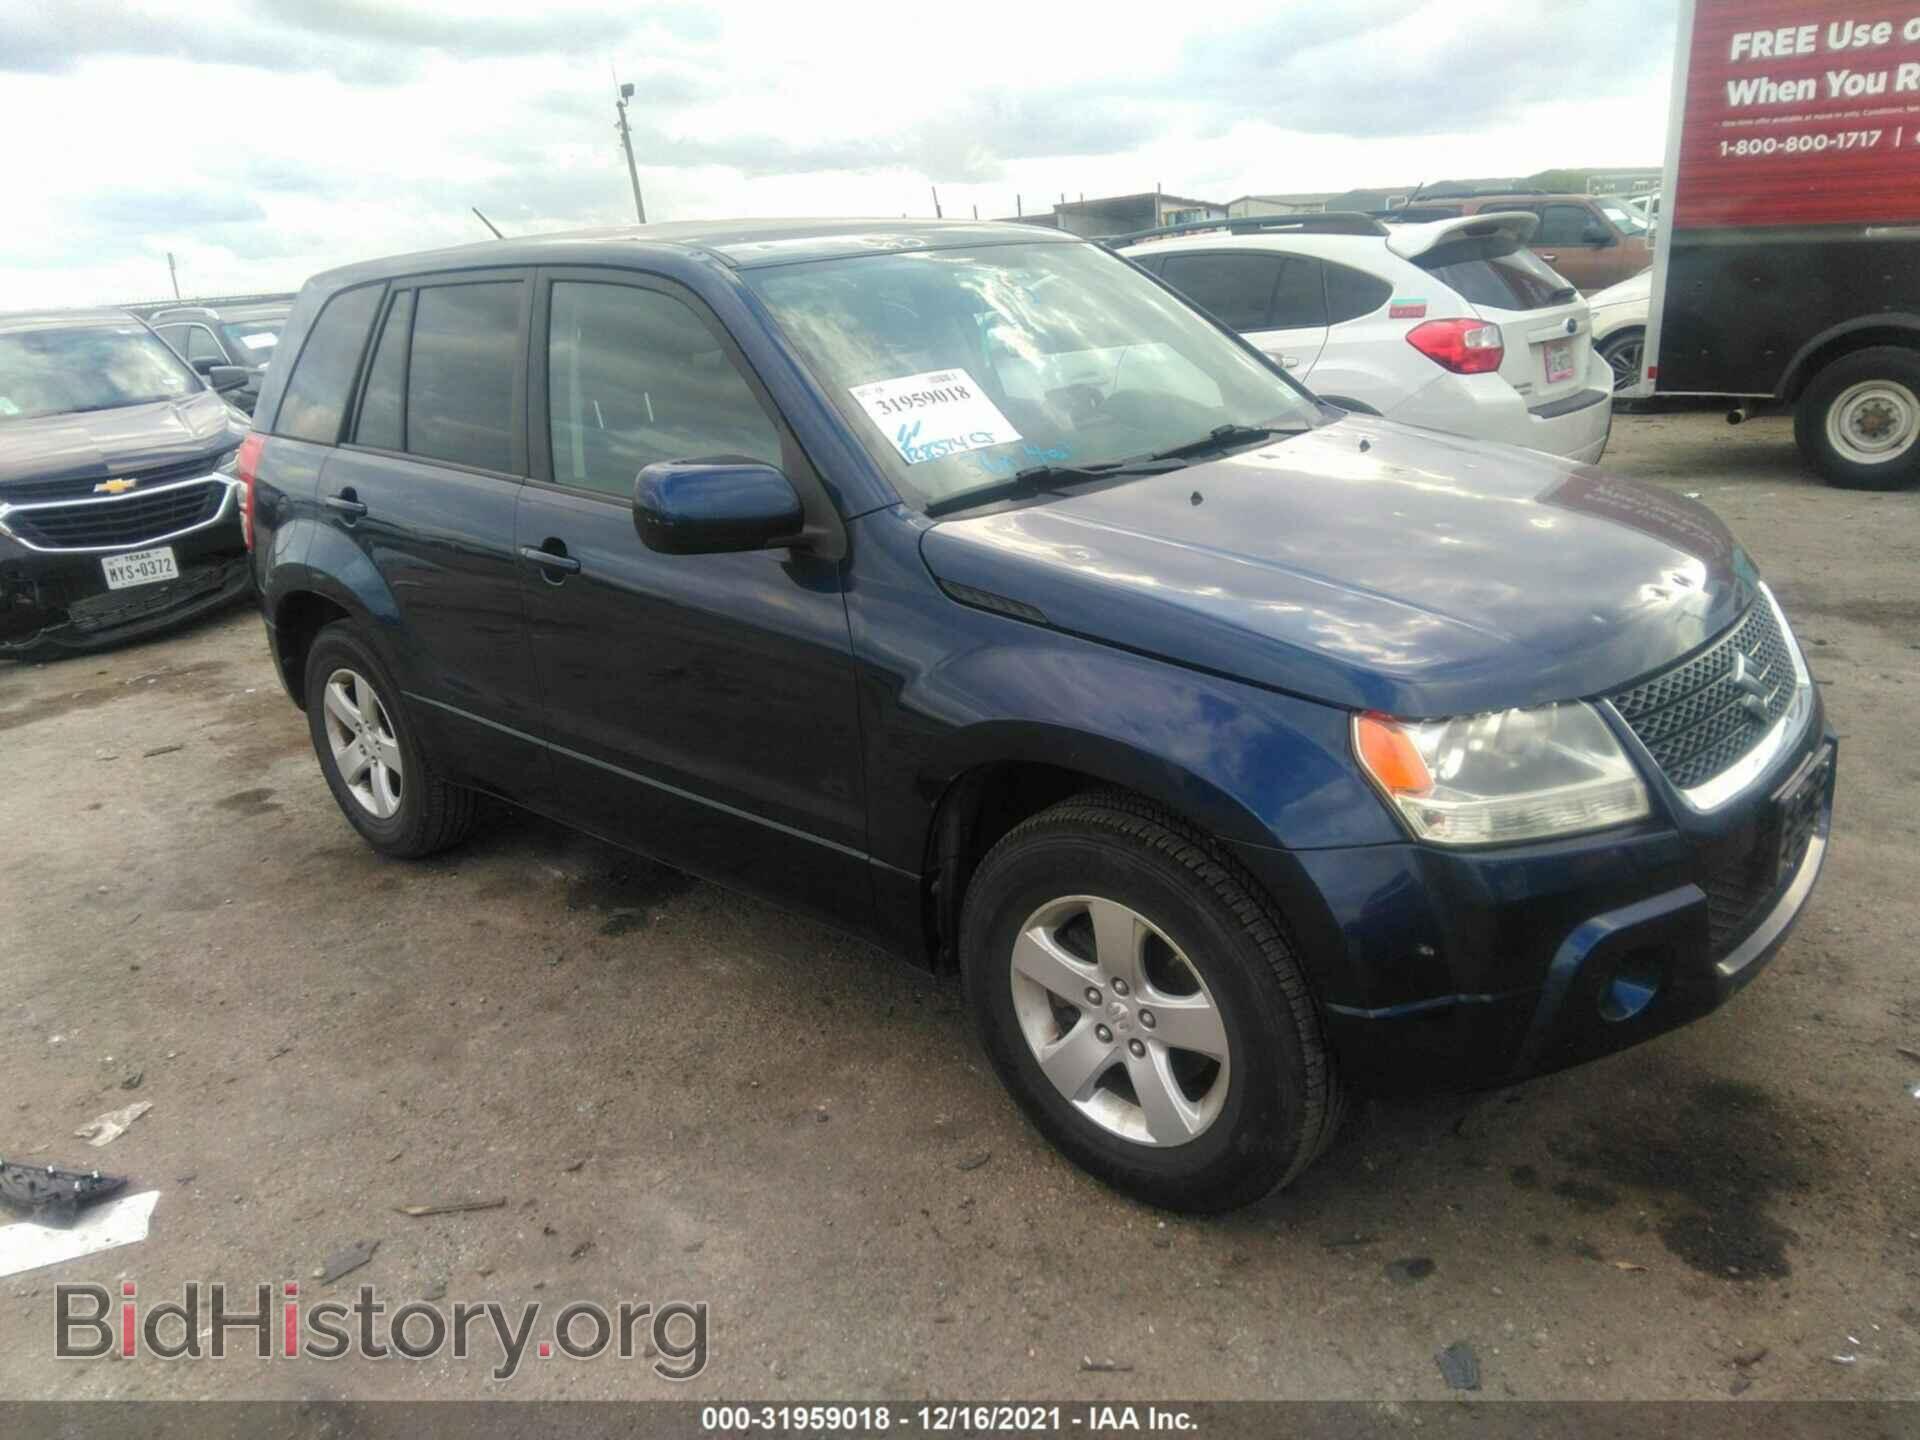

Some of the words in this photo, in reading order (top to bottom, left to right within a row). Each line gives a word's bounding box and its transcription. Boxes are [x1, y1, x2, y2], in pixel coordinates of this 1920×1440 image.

[1730, 24, 1819, 61] FREE
[1827, 20, 1892, 51] Use
[1727, 76, 1817, 107] When
[1826, 69, 1888, 98] You
[1719, 129, 1883, 157] 1-800-800-1717
[876, 384, 972, 416] 31959018
[125, 552, 152, 562] TEXAS
